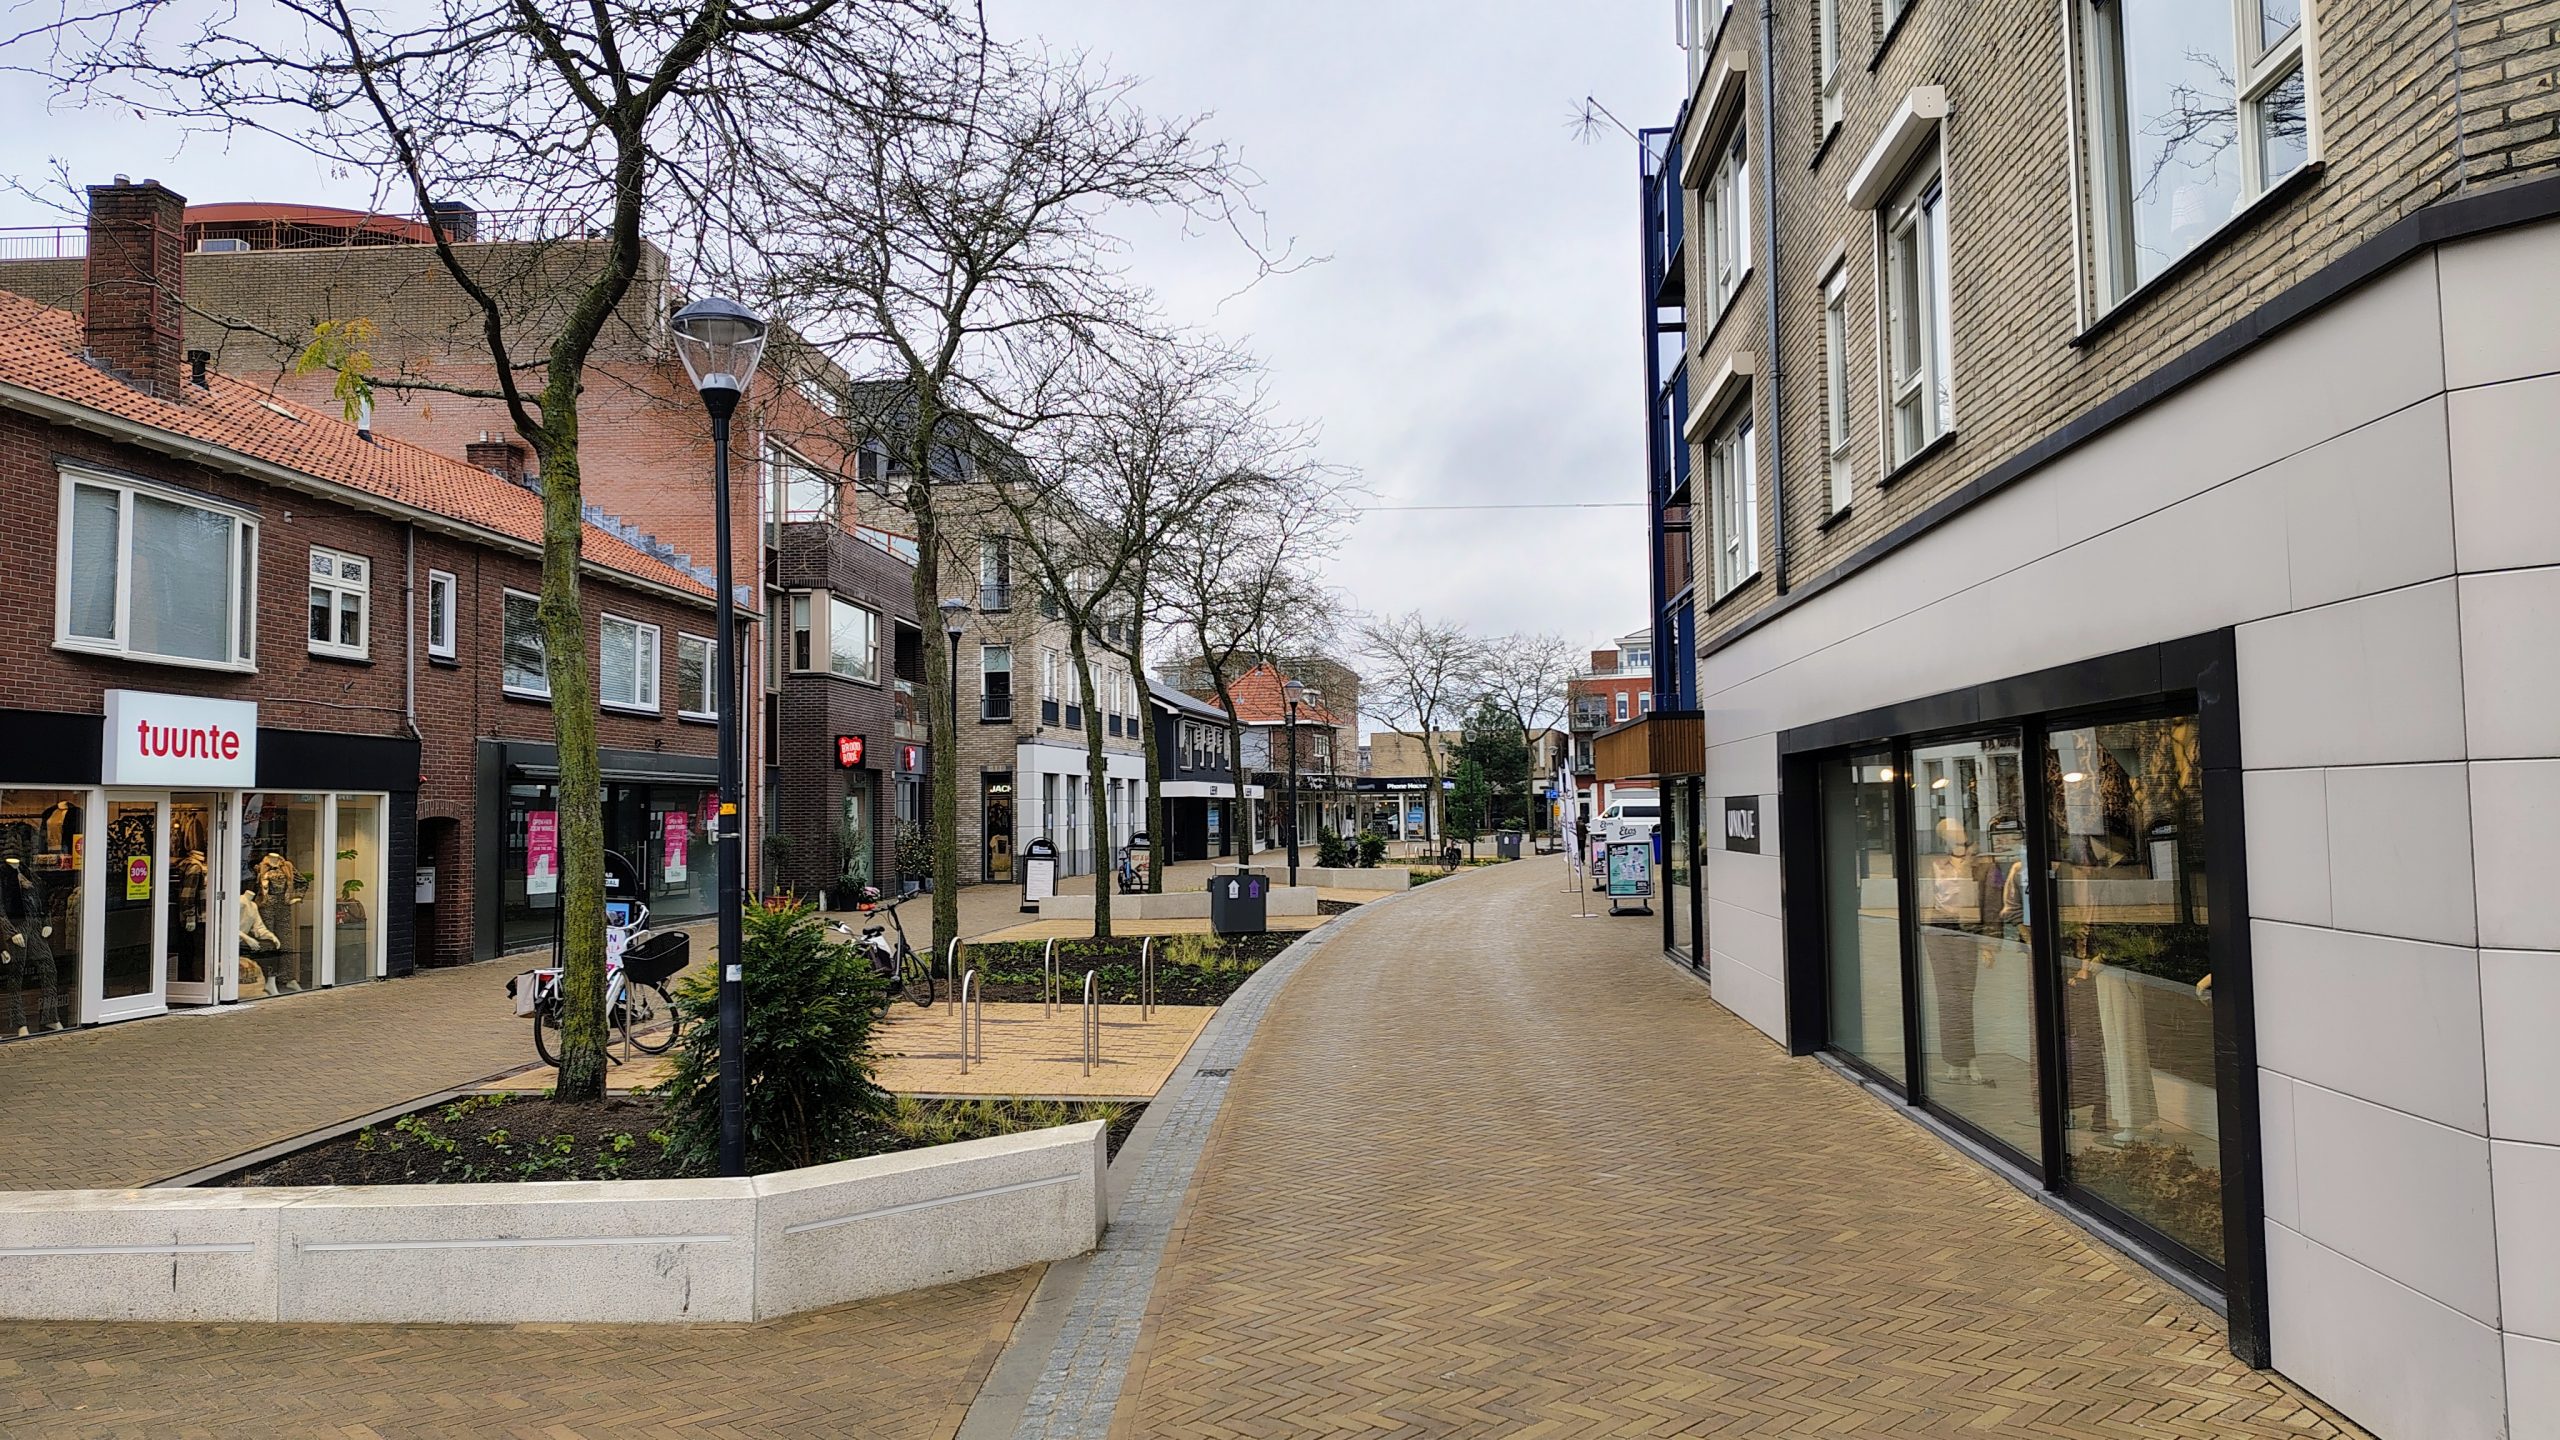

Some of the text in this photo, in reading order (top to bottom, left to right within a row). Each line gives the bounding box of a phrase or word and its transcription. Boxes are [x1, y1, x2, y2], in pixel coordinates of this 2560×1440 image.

[137, 719, 240, 760] tuunte
[1407, 782, 1428, 790] House
[1619, 825, 1637, 837] Etos
[1727, 809, 1755, 841] UNIQUE
[130, 866, 148, 877] 30%
